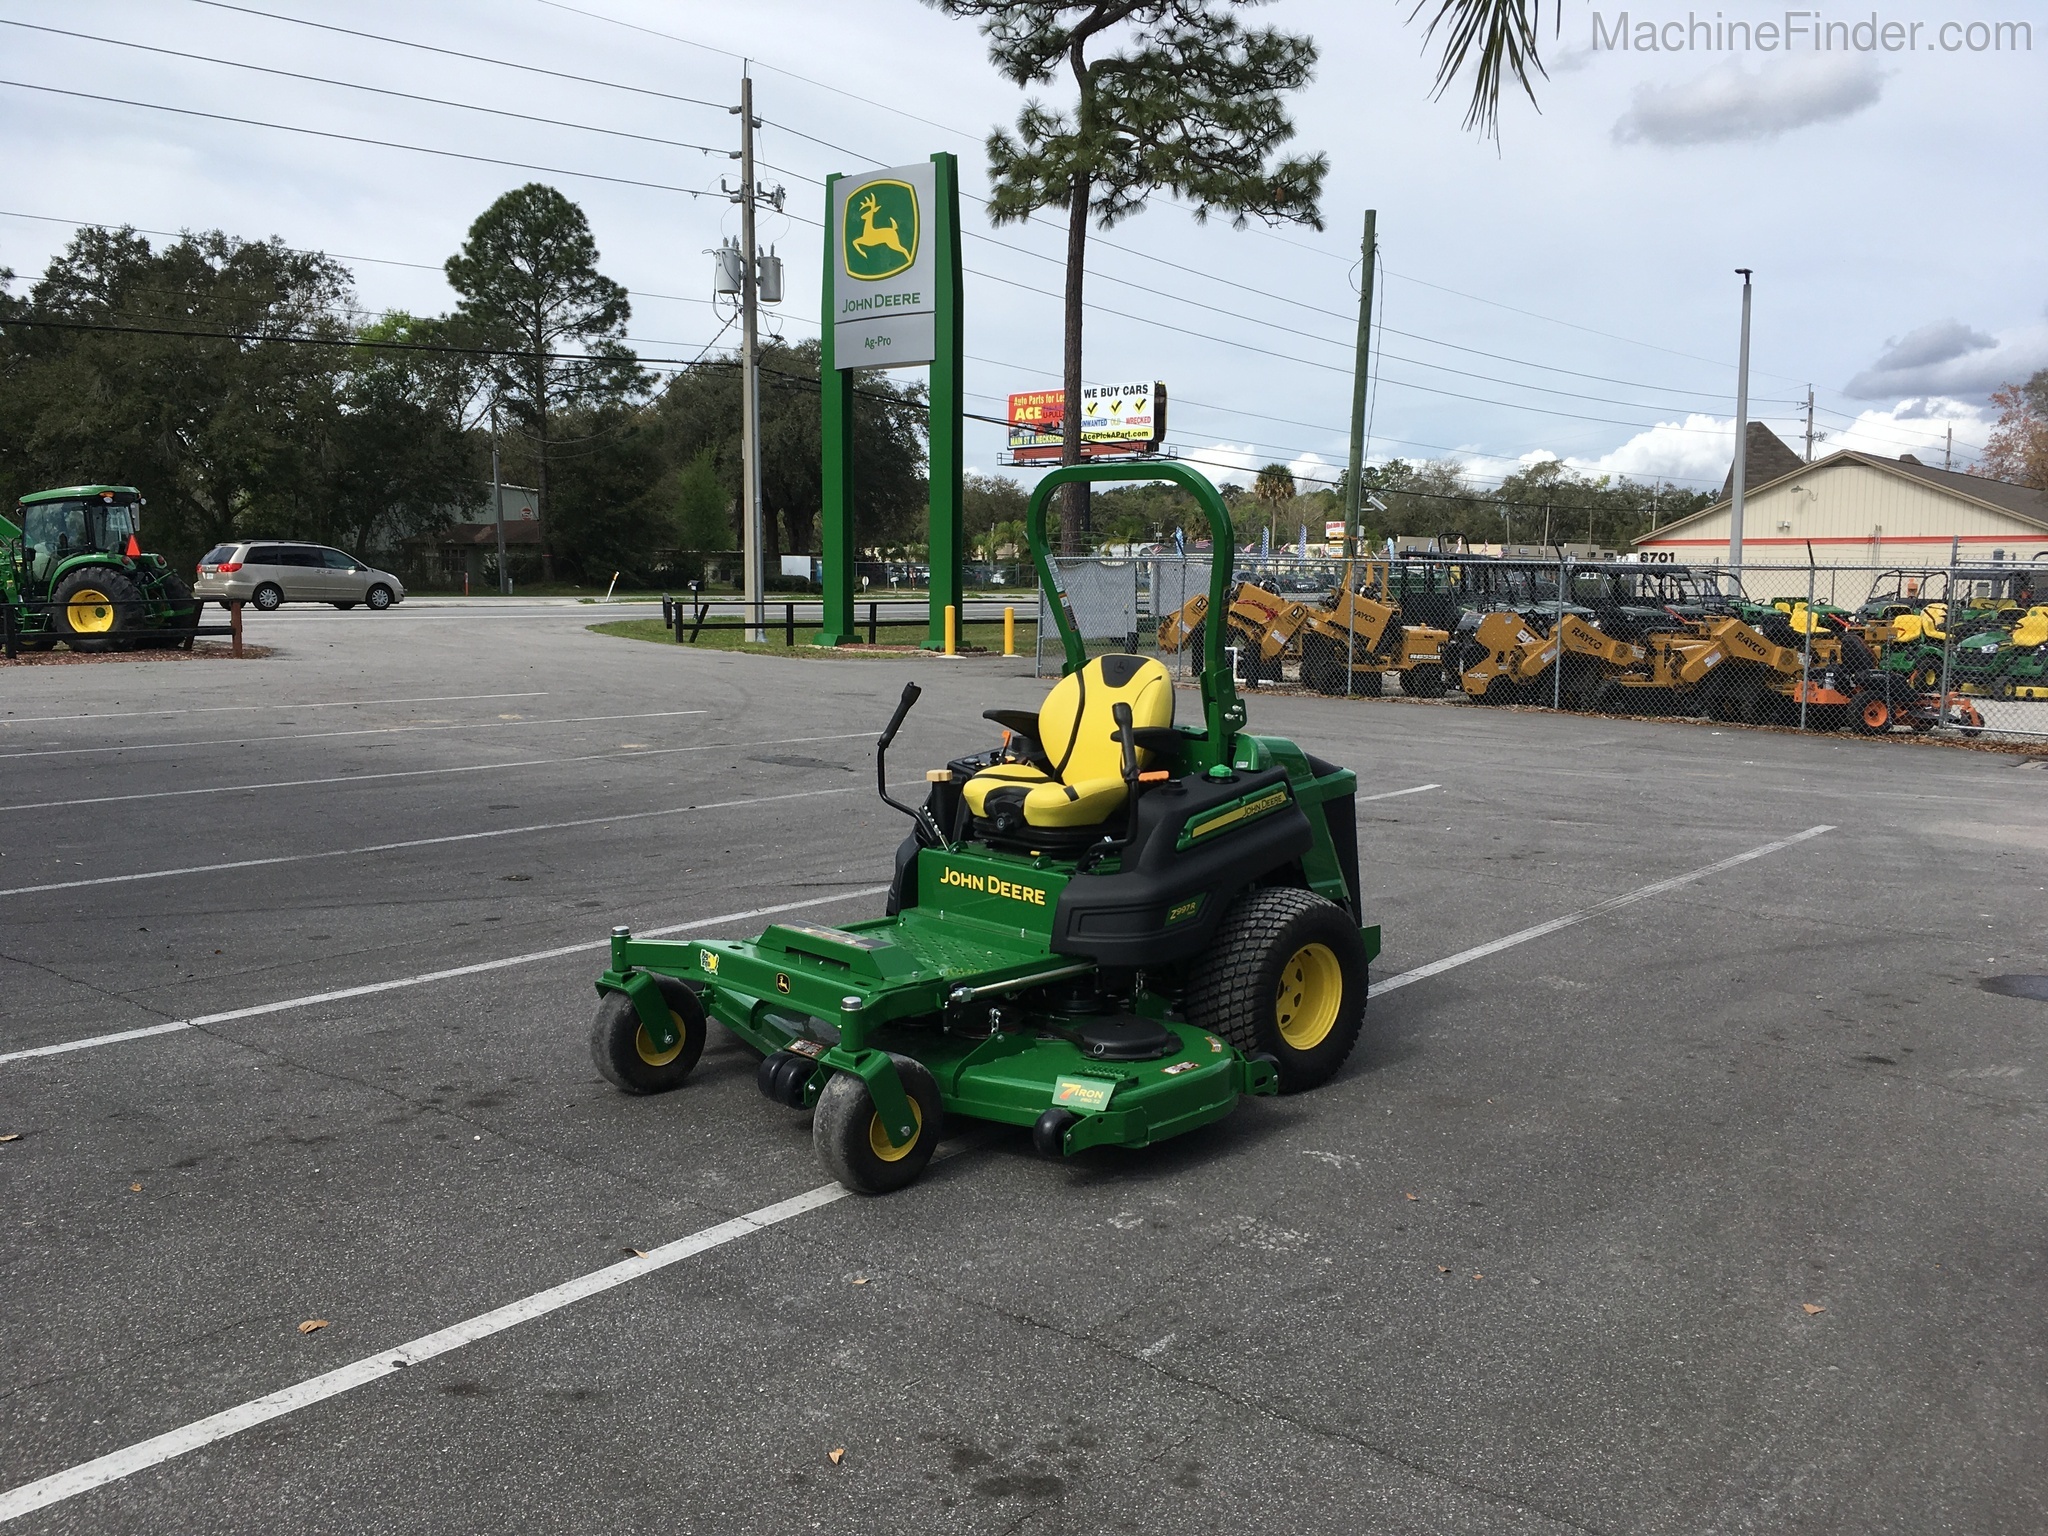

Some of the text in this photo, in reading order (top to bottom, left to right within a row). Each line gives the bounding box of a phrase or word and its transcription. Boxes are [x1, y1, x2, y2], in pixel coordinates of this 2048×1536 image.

[842, 292, 921, 313] JOHN DEERE
[864, 335, 892, 350] Ag-Pro
[1083, 384, 1149, 399] WE BUY CARS
[1014, 396, 1028, 406] Auto
[1028, 395, 1045, 405] Parts
[1045, 393, 1055, 404] for
[1014, 406, 1042, 421] ACE
[1125, 416, 1152, 425] WRECKED
[1010, 436, 1023, 446] MAIN
[1023, 436, 1030, 445] ST
[1640, 552, 1675, 563] 8701
[1571, 627, 1603, 651] RAYCO
[1734, 631, 1767, 657] RAYCO
[1242, 794, 1283, 819] JOHN DEERE
[940, 866, 1046, 906] JOHN DEERE
